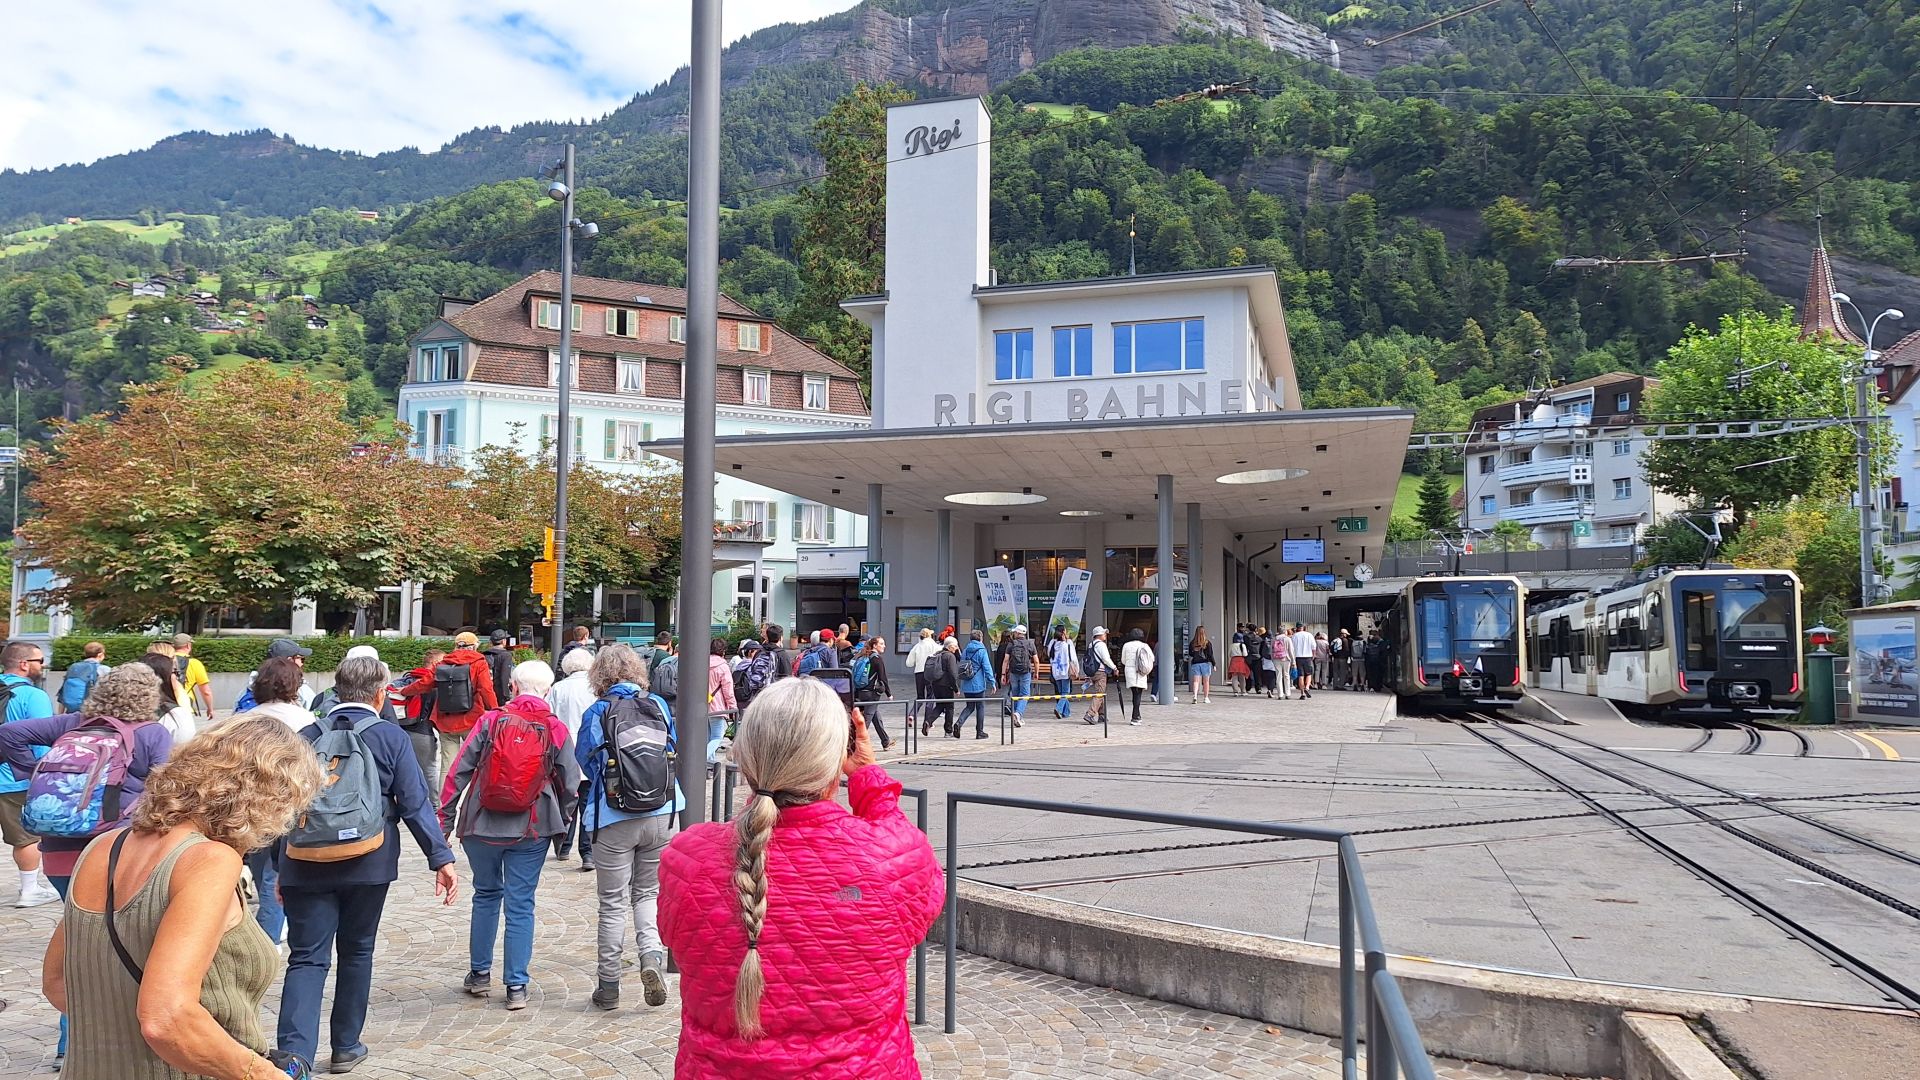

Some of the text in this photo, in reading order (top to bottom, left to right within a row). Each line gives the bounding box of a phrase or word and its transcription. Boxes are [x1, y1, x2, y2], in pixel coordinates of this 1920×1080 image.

[904, 118, 963, 155] Rigi
[934, 376, 1284, 424] RIGI BAHNEN
